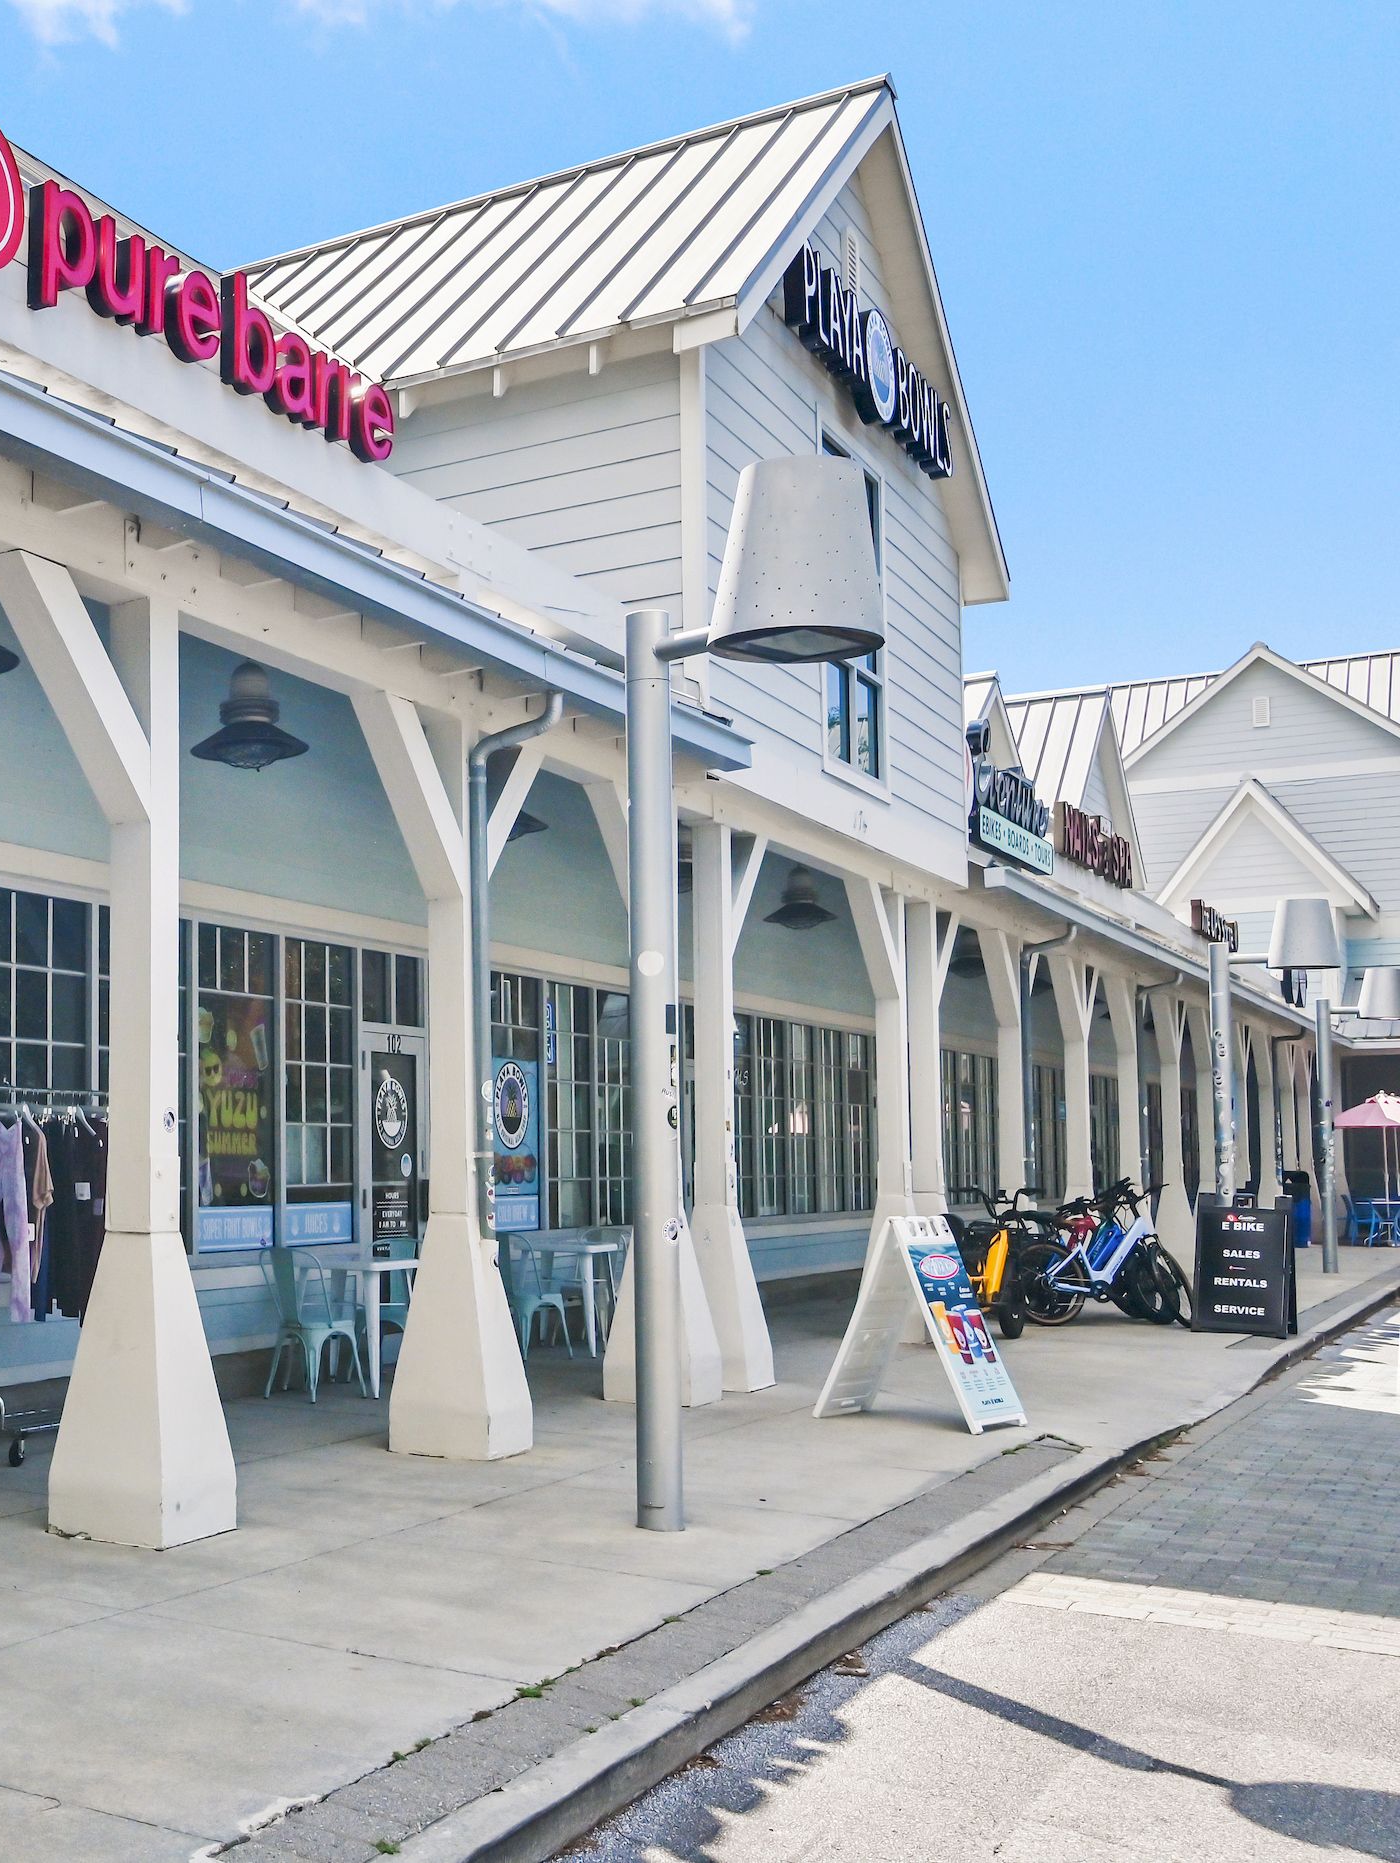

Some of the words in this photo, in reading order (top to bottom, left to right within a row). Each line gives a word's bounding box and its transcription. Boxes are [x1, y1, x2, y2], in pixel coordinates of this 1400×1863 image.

[27, 178, 221, 364] pure
[219, 270, 395, 464] barre
[803, 238, 866, 382] PLAYA
[896, 346, 953, 478] BOWLS
[982, 813, 1002, 842] EBIKES
[1007, 827, 1029, 856] BOARDS
[1034, 842, 1051, 868] TOURS
[1063, 801, 1100, 869] NAILS
[1111, 833, 1133, 889] SPA
[386, 1034, 402, 1054] 102
[495, 1066, 511, 1101] PLAYA
[511, 1065, 528, 1102] BOWLS
[377, 1080, 393, 1111] PLAYA
[392, 1080, 408, 1111] BOWLS
[206, 1088, 259, 1129] YUZU
[206, 1130, 258, 1156] SUMMER
[384, 1191, 400, 1200] HOURS
[304, 1212, 328, 1233] JUICES
[381, 1210, 403, 1218] EVERYDAY
[1221, 1221, 1230, 1231] E
[1233, 1221, 1265, 1232] BIKE
[1222, 1248, 1261, 1259] SALES
[1213, 1276, 1268, 1289] RENTALS
[1213, 1304, 1265, 1316] SERVICE
